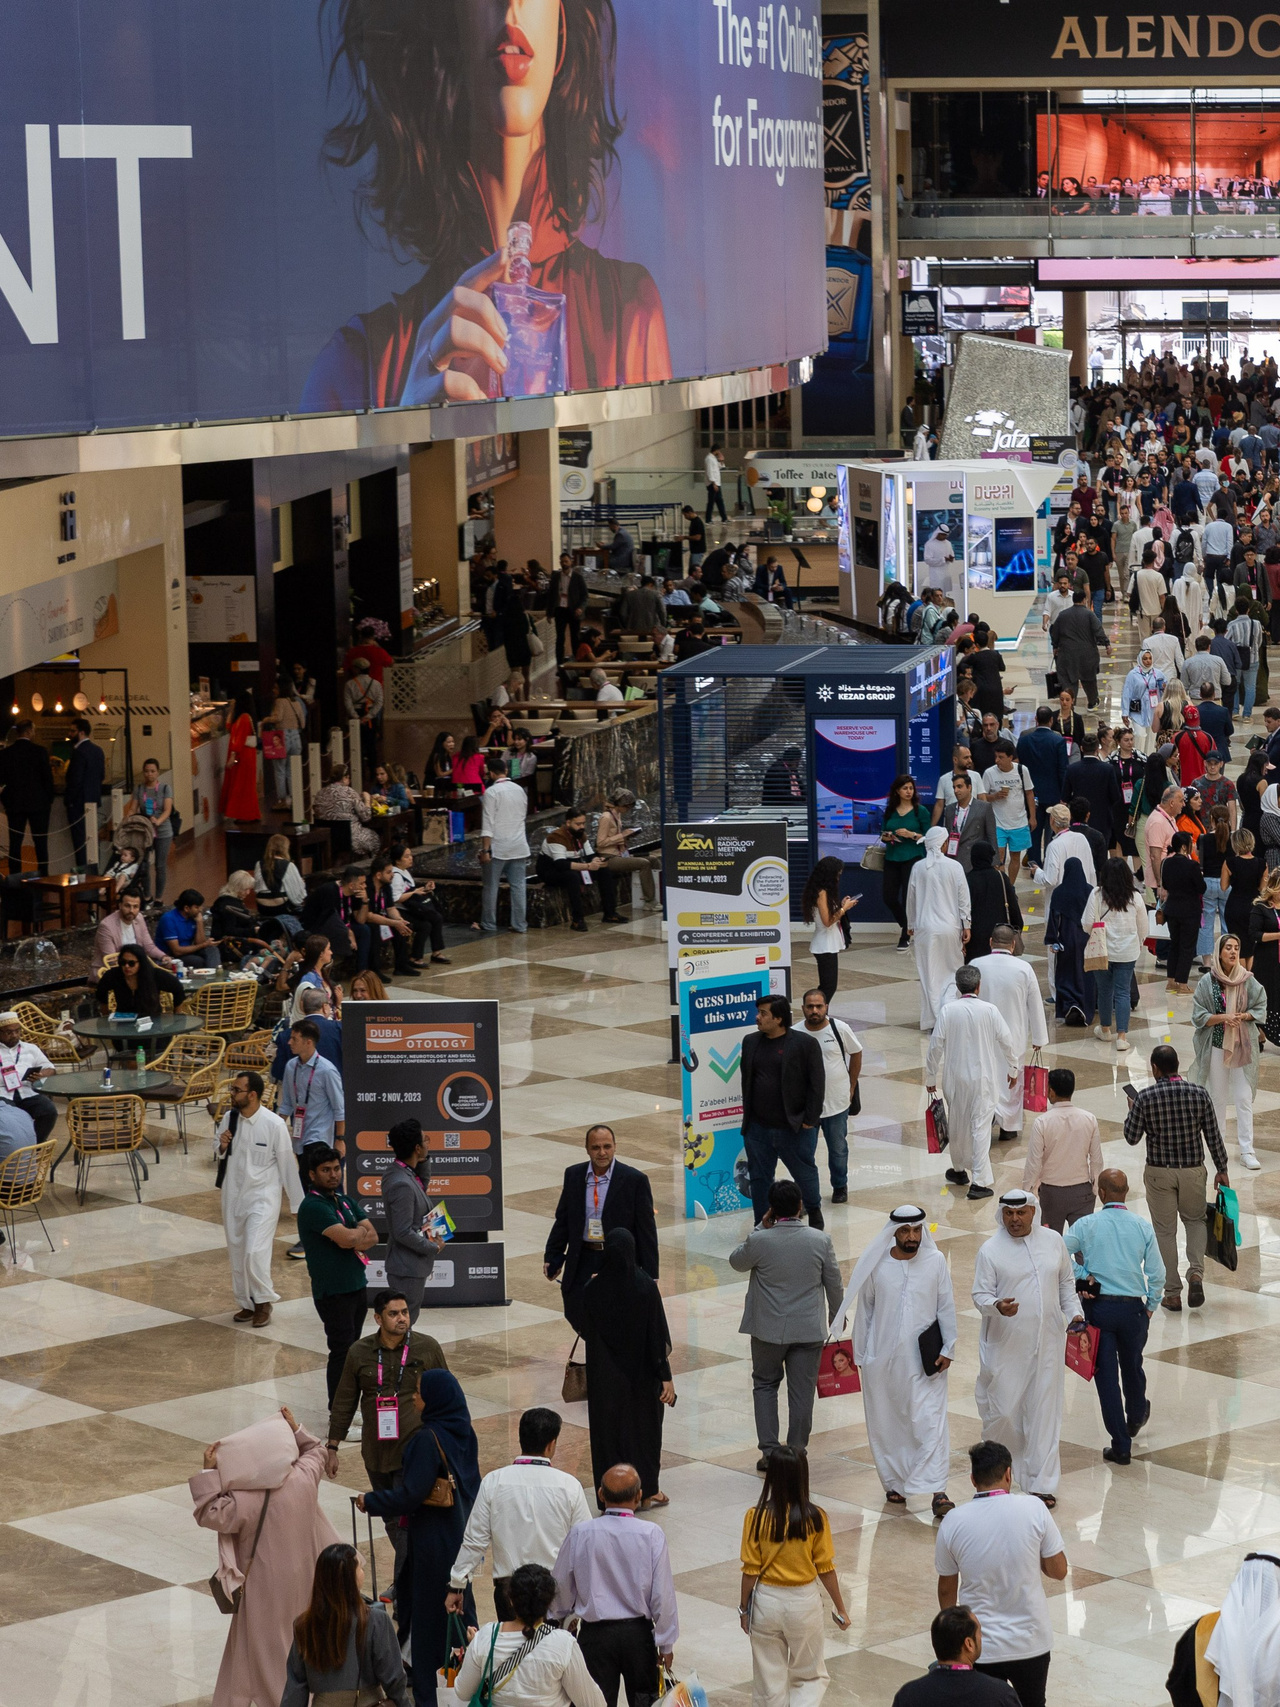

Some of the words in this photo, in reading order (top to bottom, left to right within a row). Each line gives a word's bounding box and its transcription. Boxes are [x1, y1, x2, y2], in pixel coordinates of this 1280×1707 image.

[713, 0, 752, 68] The
[758, 4, 774, 70] #1
[778, 5, 812, 77] Online
[712, 95, 742, 167] for
[747, 98, 816, 187] Fragrances
[987, 428, 1040, 452] jafz
[774, 468, 804, 479] Toffee
[677, 838, 714, 850] ARM
[695, 994, 724, 1009] GESS
[725, 990, 757, 1004] Dubai
[704, 1011, 725, 1024] this
[726, 1010, 748, 1021] way
[370, 1029, 402, 1038] DUBAI
[406, 1039, 468, 1048] OTOLOGY
[404, 1092, 421, 1102] 2023
[700, 1096, 727, 1108] Za'abeel
